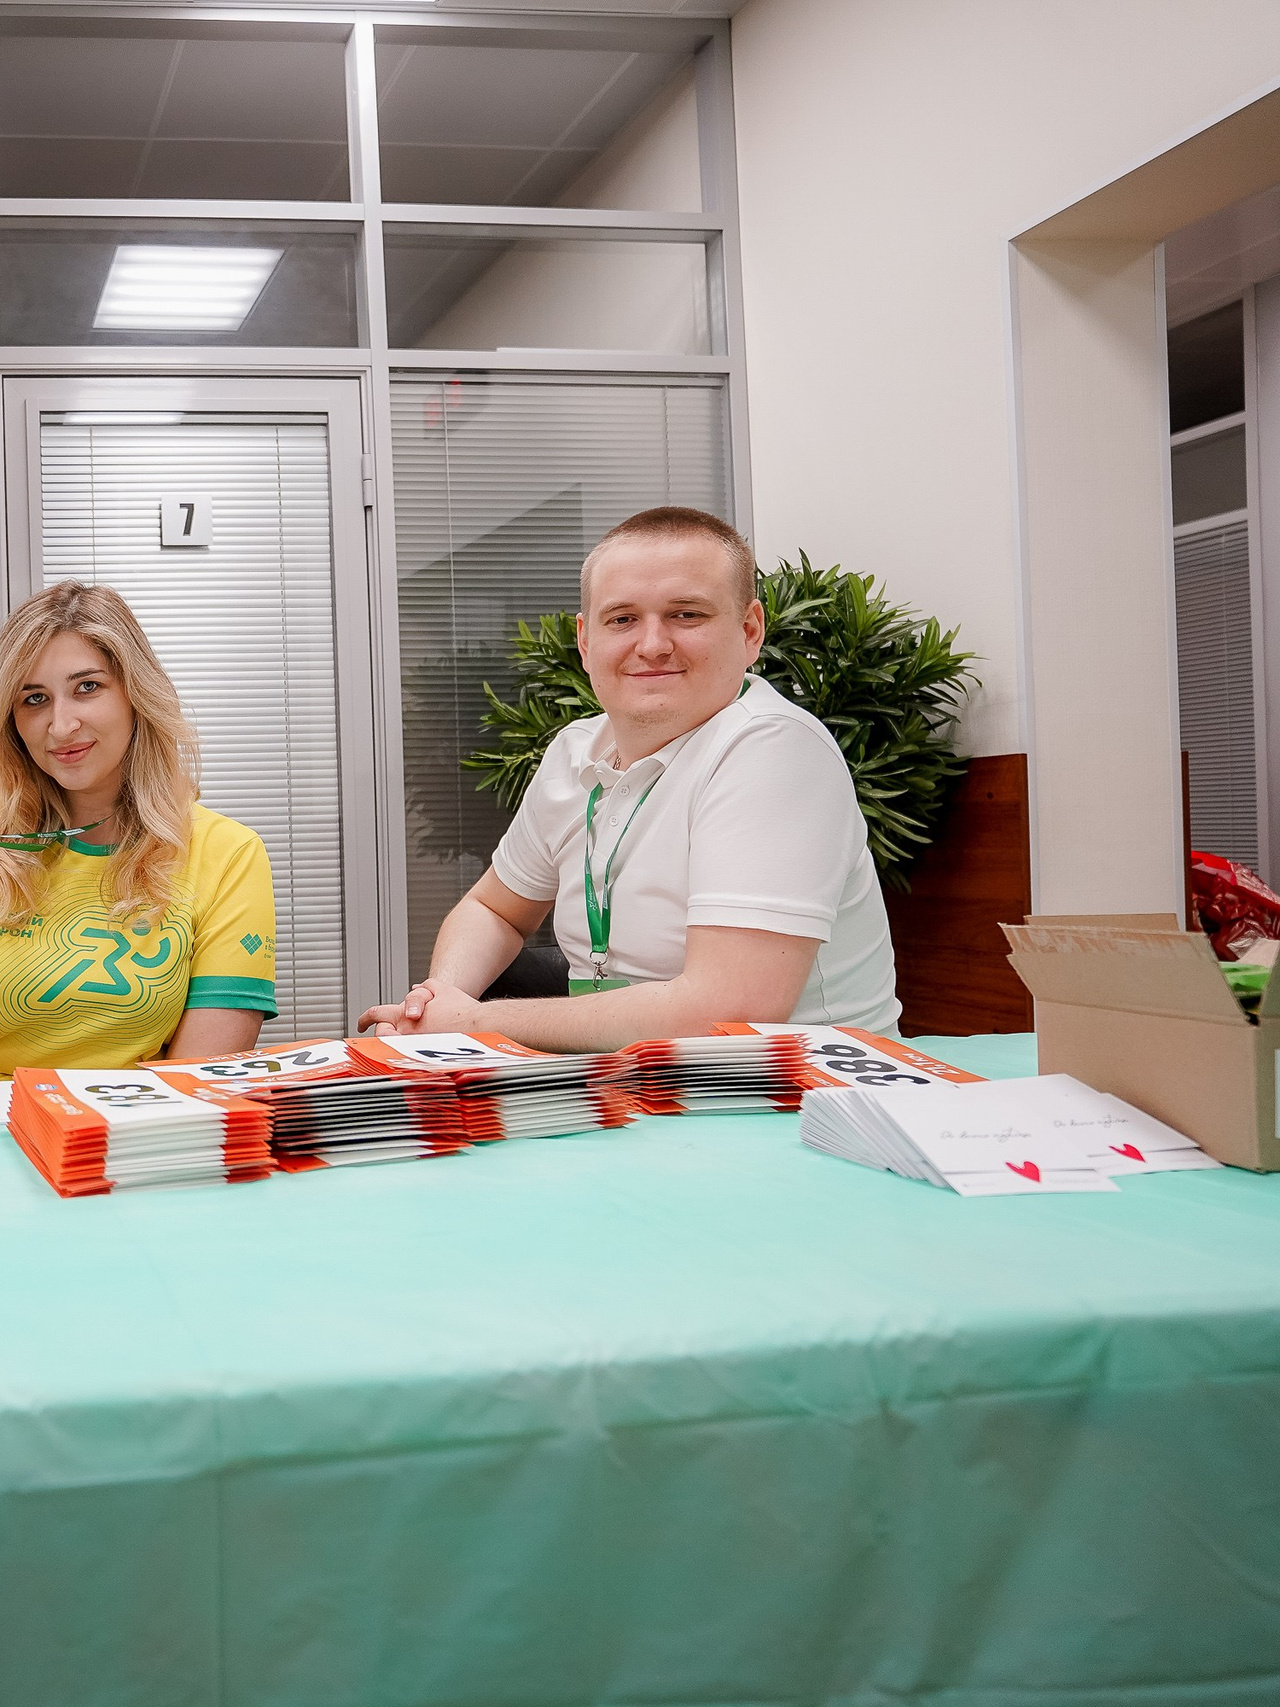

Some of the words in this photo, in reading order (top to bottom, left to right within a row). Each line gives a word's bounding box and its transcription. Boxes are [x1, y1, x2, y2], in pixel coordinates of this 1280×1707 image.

[179, 503, 195, 536] 7
[200, 1051, 329, 1077] 263
[810, 1044, 931, 1087] 386
[84, 1084, 183, 1107] 183
